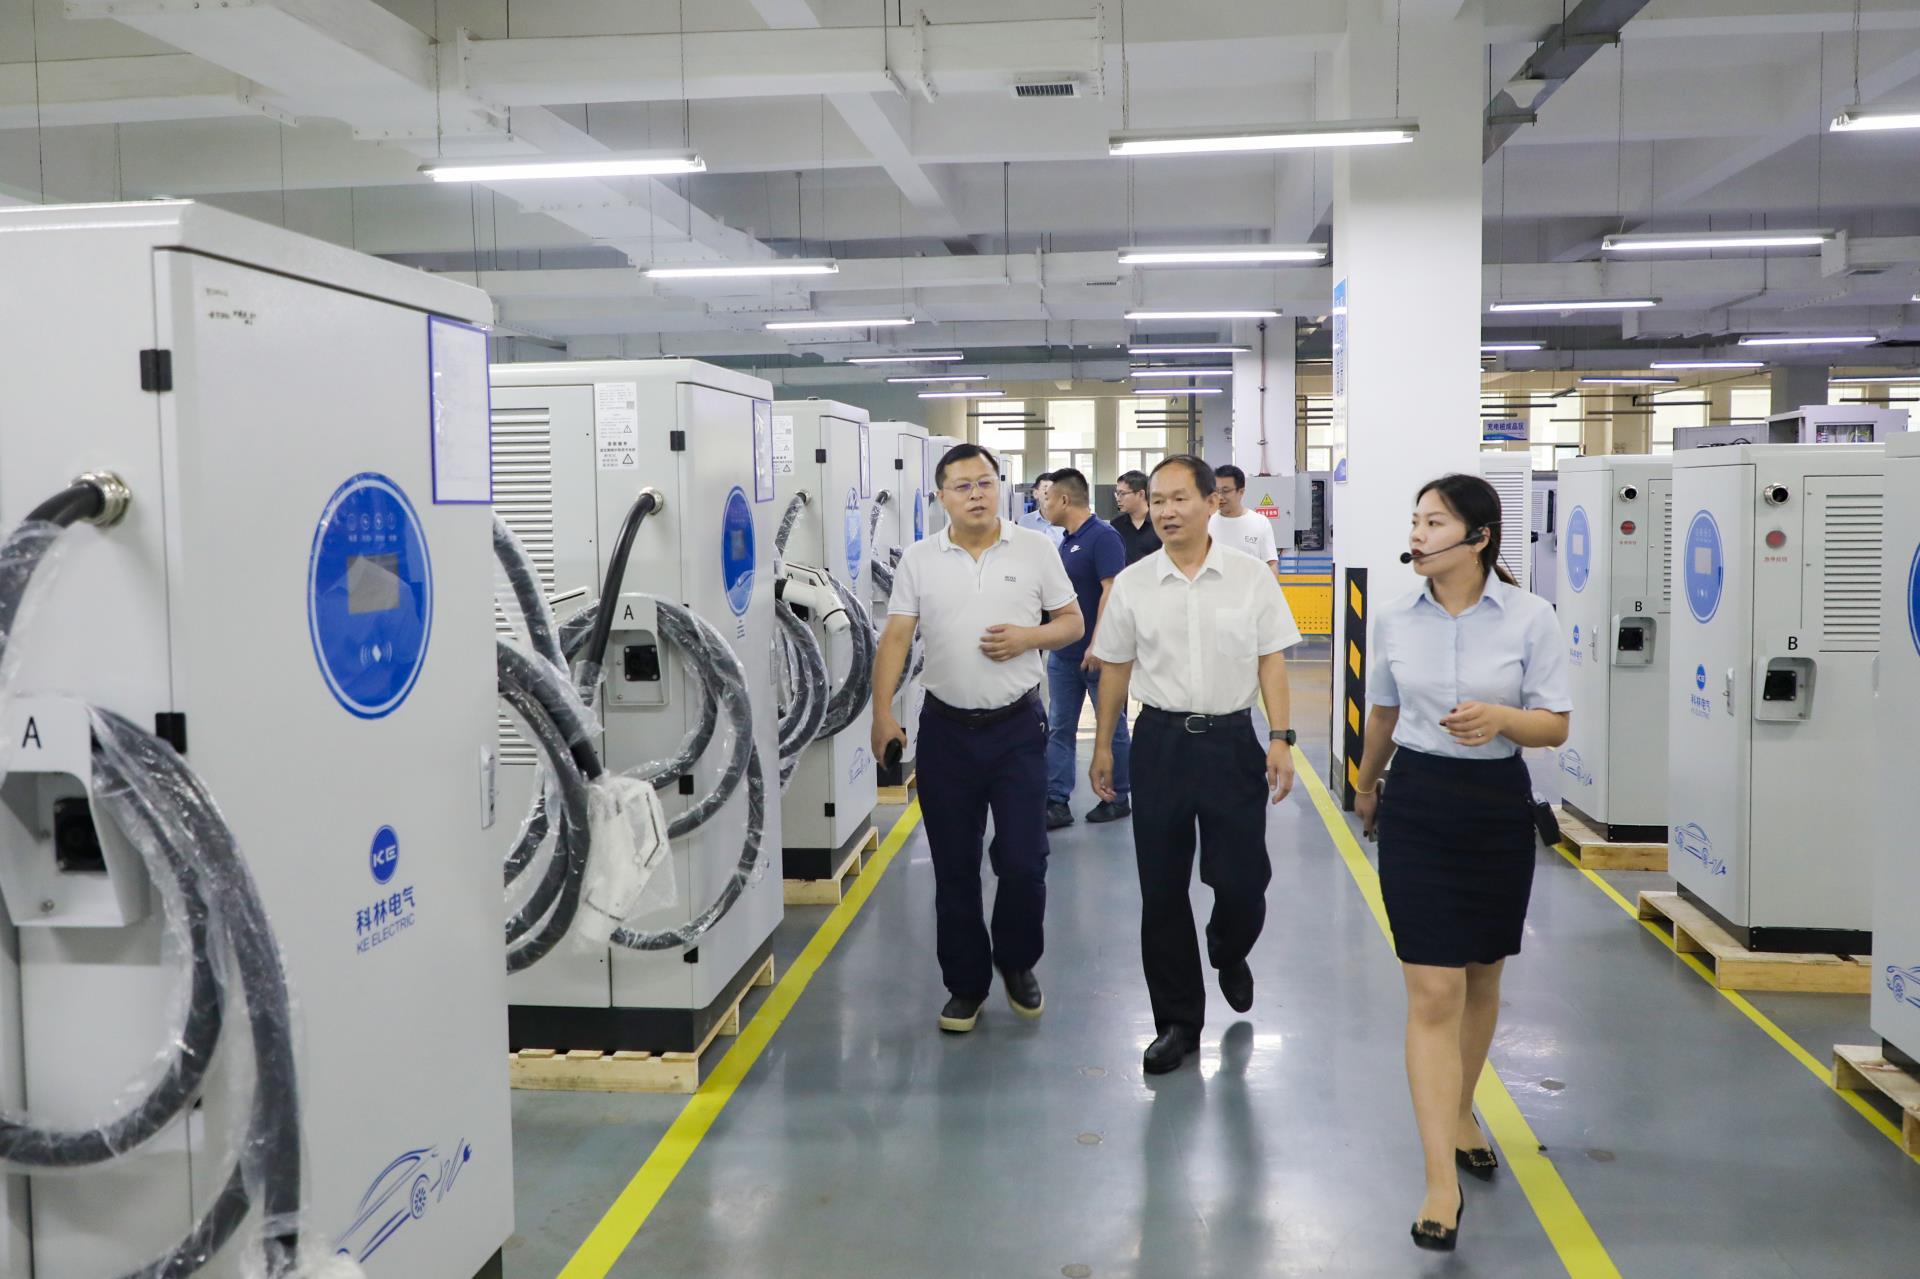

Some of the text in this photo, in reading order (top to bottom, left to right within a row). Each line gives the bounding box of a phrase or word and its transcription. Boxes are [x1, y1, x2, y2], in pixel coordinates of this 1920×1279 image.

[623, 603, 634, 621] A
[1635, 601, 1643, 612] B
[1788, 636, 1799, 651] B
[22, 716, 42, 749] A
[372, 844, 397, 868] KE
[356, 885, 416, 936] 科林电气
[356, 912, 416, 955] KE ELECTRIC
